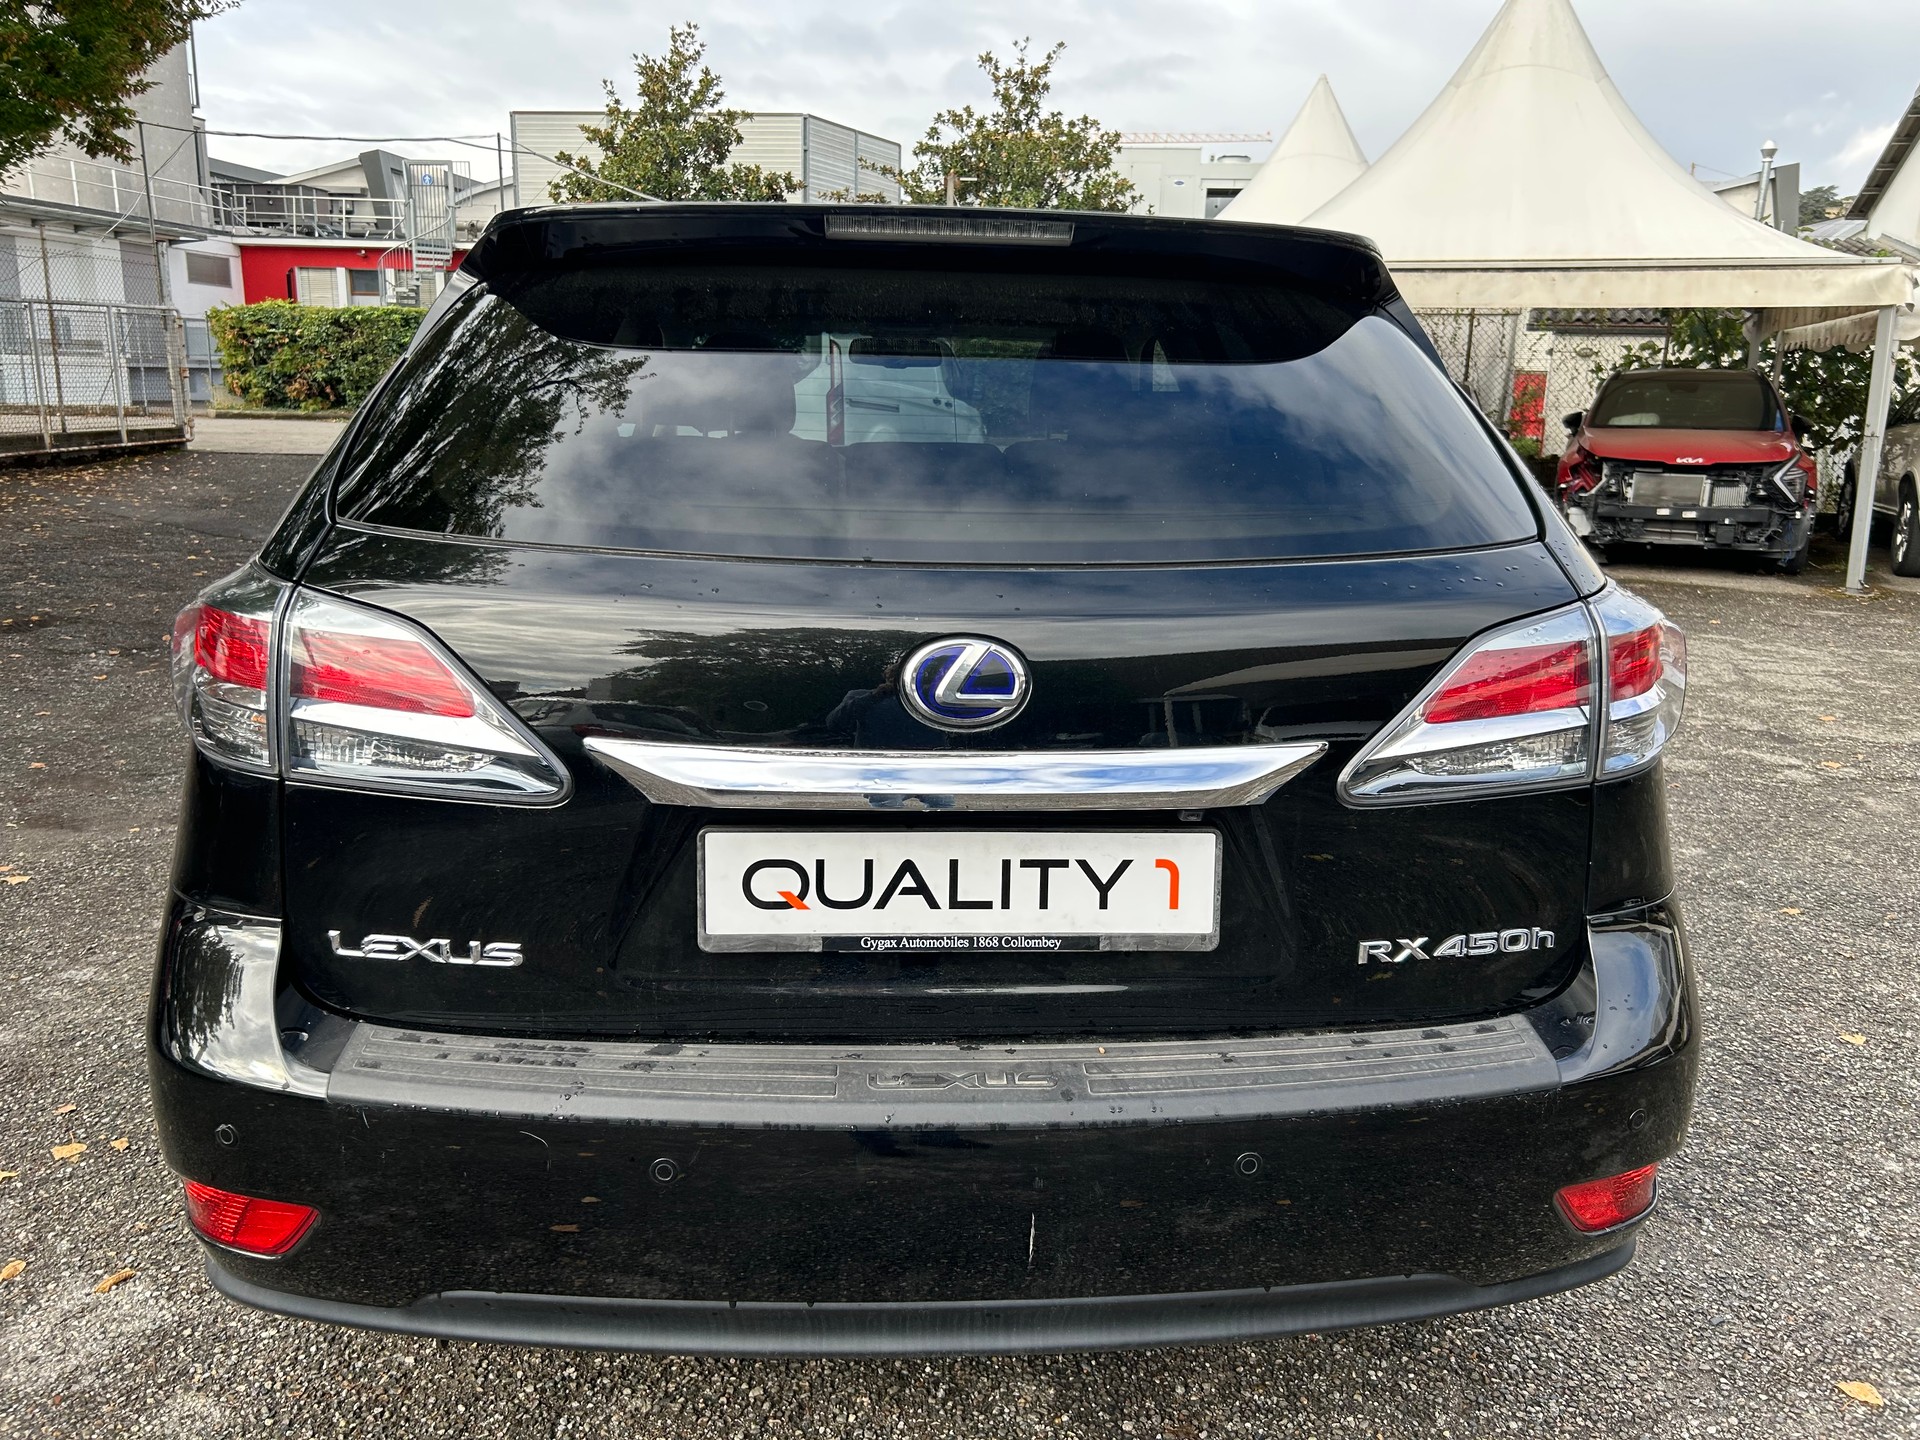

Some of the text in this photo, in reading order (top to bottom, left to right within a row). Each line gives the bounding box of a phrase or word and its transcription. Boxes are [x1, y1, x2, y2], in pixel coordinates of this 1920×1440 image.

[741, 858, 1180, 910] QUALITY 1
[327, 929, 524, 967] LEXUS
[860, 936, 1062, 950] Gygax Automobiles 1868 Collombey
[866, 1071, 1059, 1090] LEXUS
